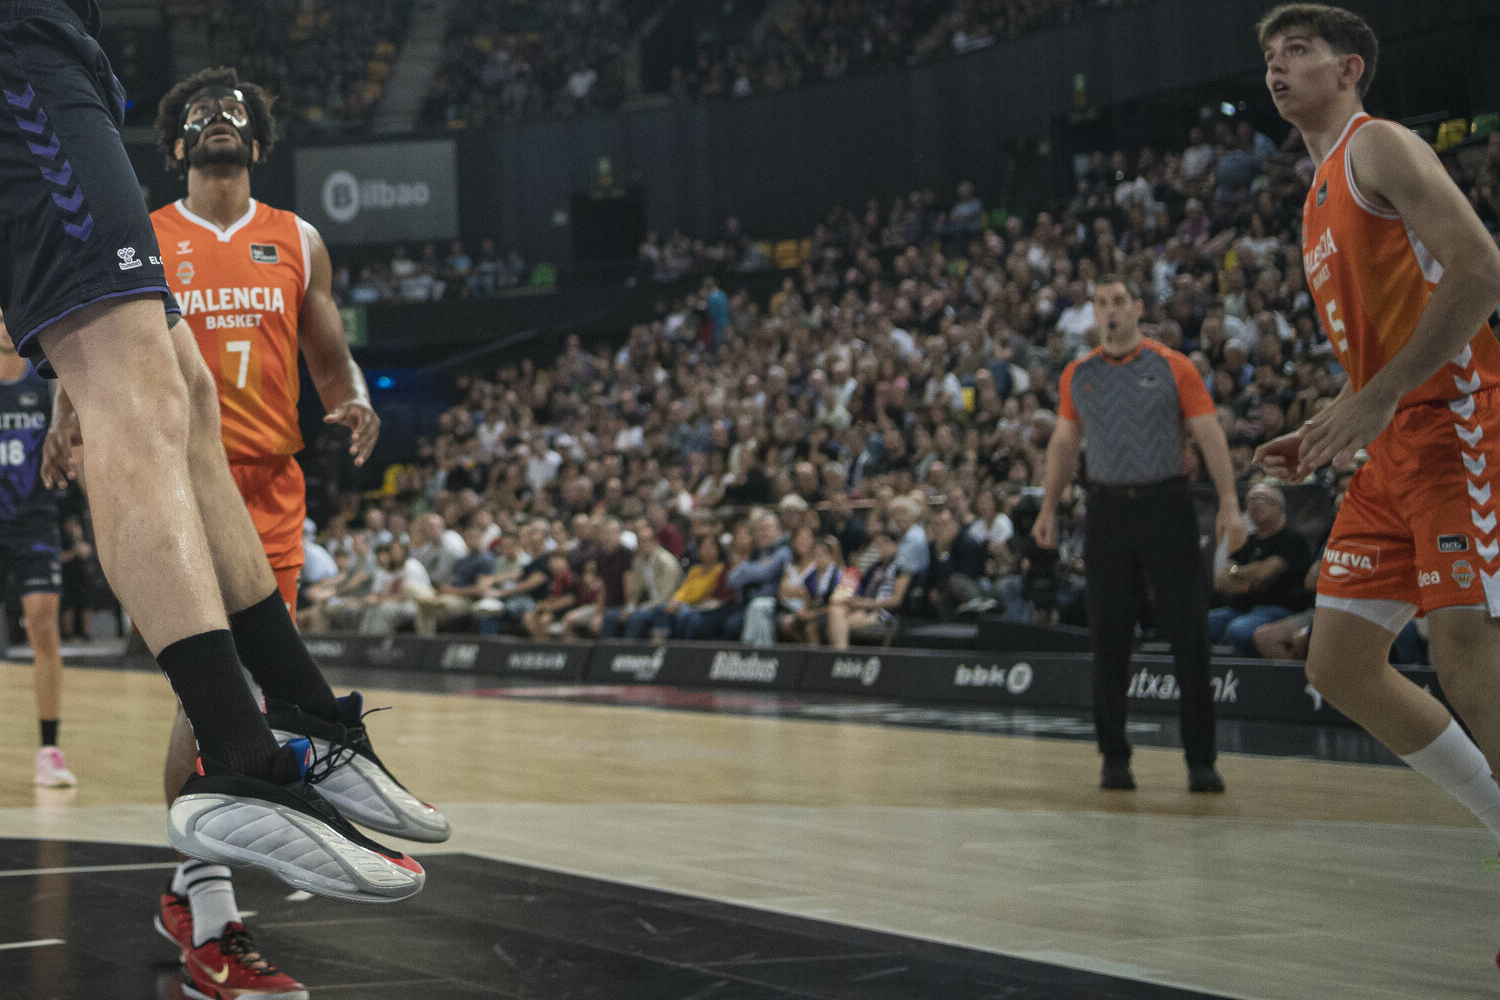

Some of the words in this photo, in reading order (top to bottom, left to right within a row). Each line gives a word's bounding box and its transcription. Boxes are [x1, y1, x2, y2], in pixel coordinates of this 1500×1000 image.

[174, 287, 285, 317] VALENCIA
[205, 313, 263, 331] BASKET
[226, 340, 251, 389] 7
